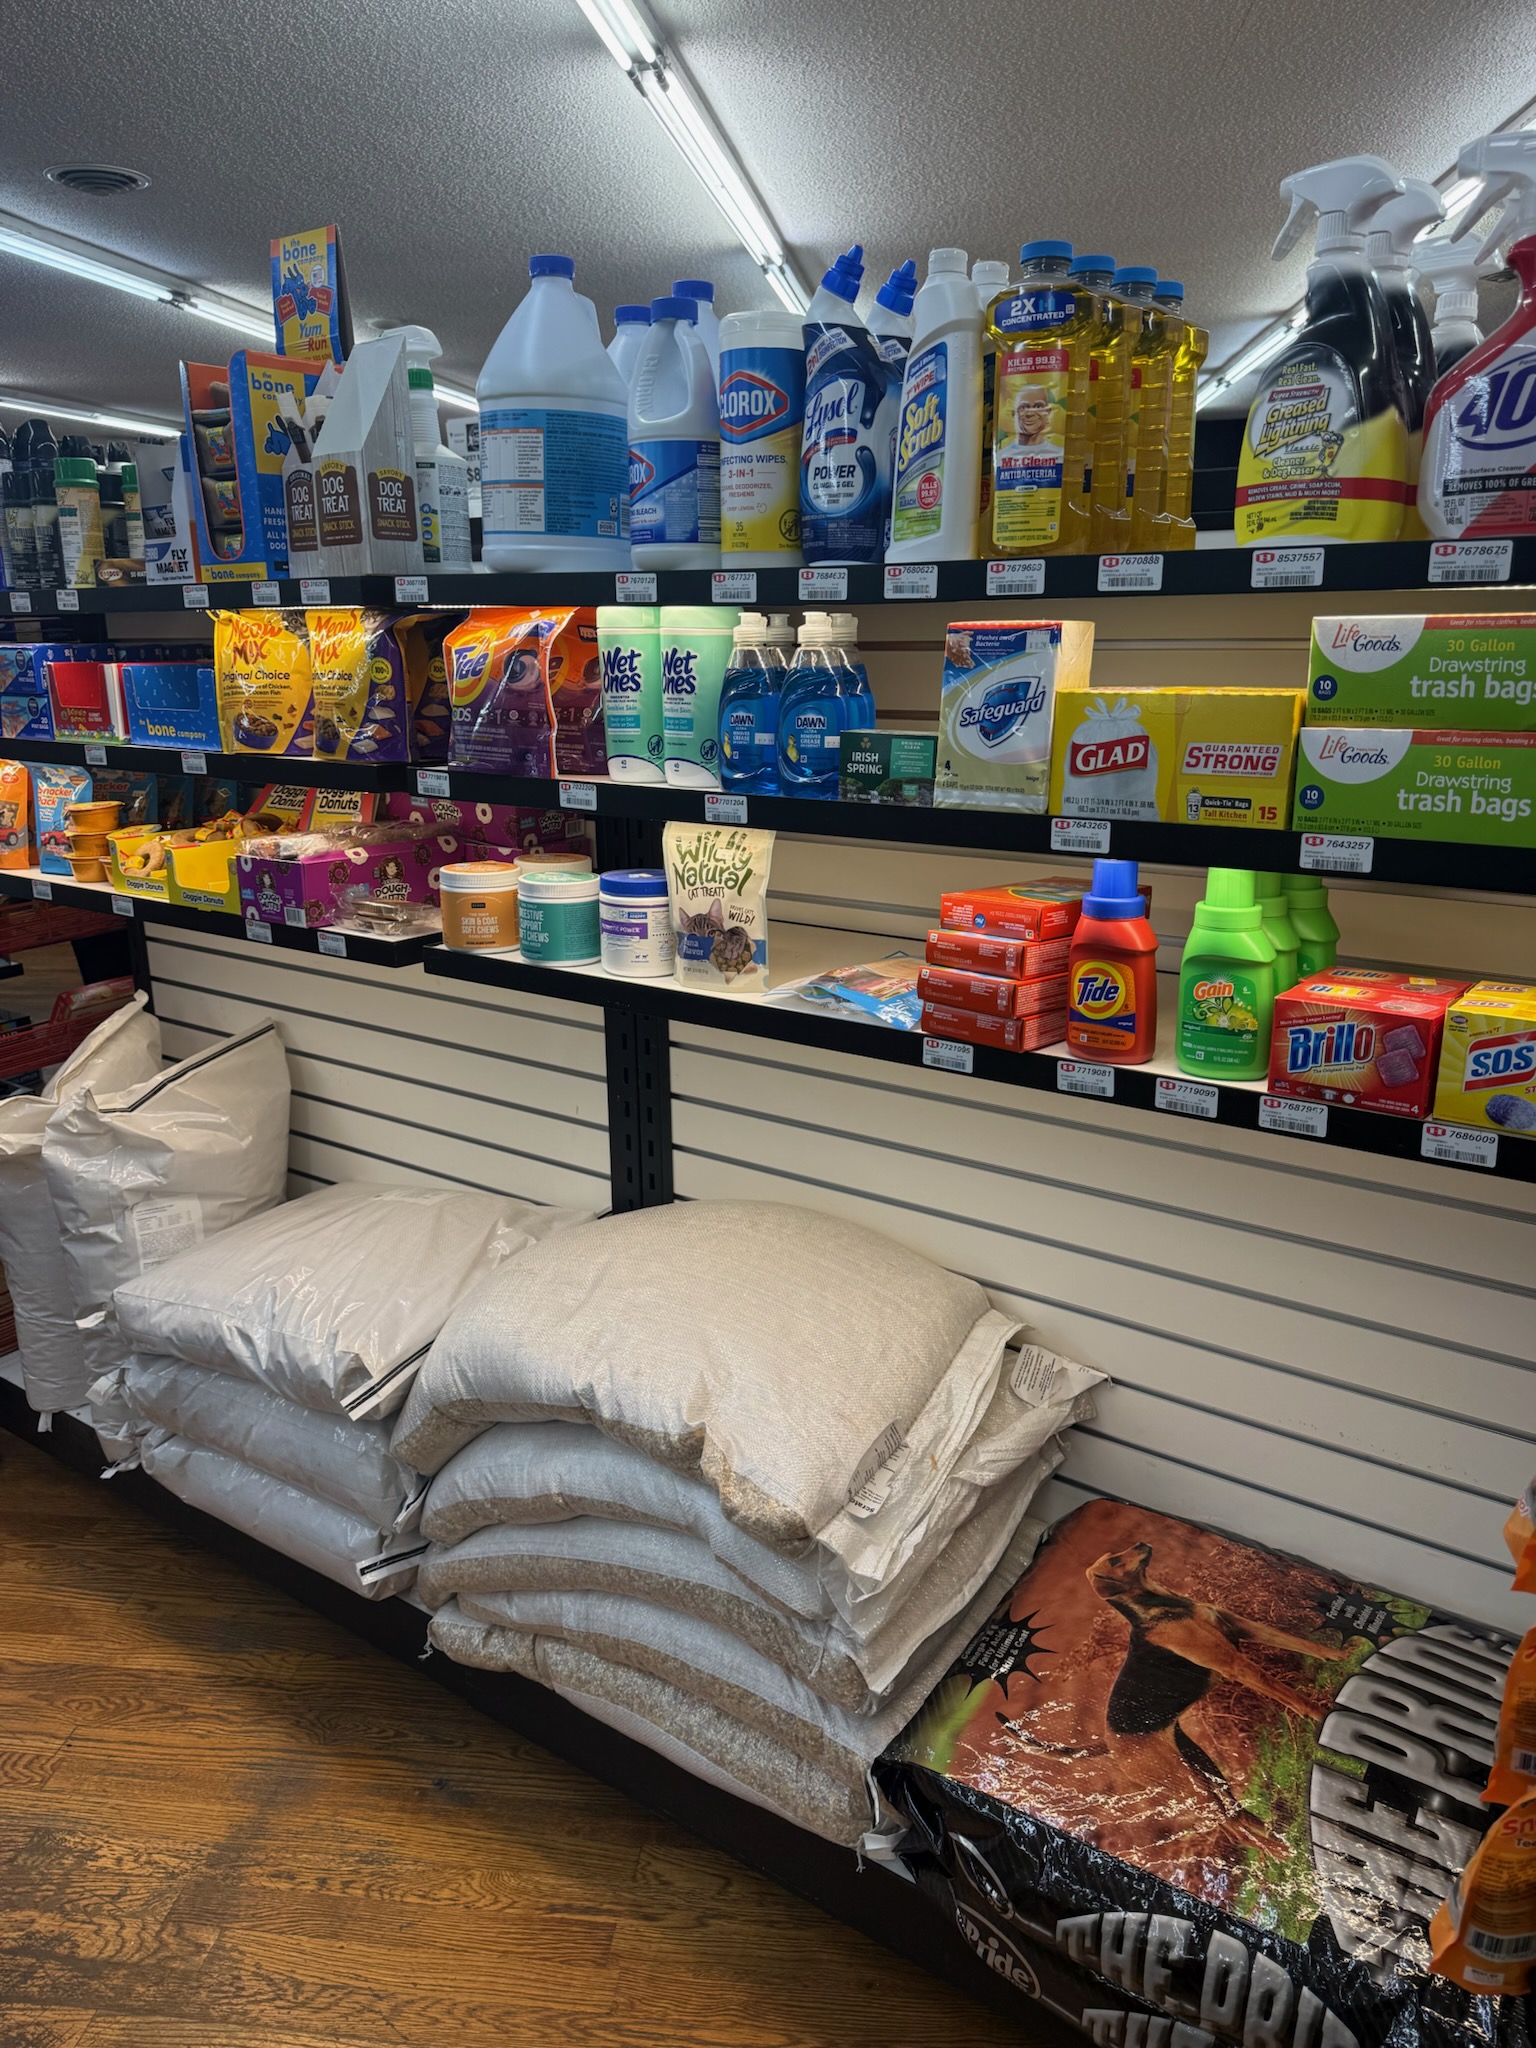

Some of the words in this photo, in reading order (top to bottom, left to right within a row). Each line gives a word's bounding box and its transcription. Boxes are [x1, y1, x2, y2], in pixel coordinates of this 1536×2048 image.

[283, 243, 316, 262] bone
[1010, 298, 1036, 317] 2X
[1001, 311, 1065, 327] CONCENTRATED
[299, 323, 322, 338] Yum
[308, 338, 327, 352] Run
[1007, 357, 1033, 367] KILLS
[1282, 365, 1299, 375] Real
[1300, 362, 1318, 372] Fast.
[251, 373, 294, 393] bone
[913, 371, 935, 391] WIPE
[1278, 377, 1295, 386] Real
[1296, 374, 1321, 384] Clean.
[720, 390, 776, 419] CLOROX
[806, 382, 859, 439] Lysol
[1266, 388, 1331, 423] Greased
[905, 392, 940, 433] Soft
[1260, 413, 1332, 444] Lightning
[899, 418, 944, 472] Scrub
[1022, 456, 1057, 467] Clean
[1272, 457, 1305, 468] Cleaner
[379, 470, 403, 479] SAVORY
[728, 469, 754, 478] 3-IN-1
[814, 465, 856, 480] POWER
[1000, 469, 1057, 480] ANTIBACTERIAL
[1271, 466, 1316, 480] Degreaser
[322, 476, 344, 495] DOG
[379, 481, 403, 497] DOG
[842, 480, 855, 488] GEL
[921, 482, 937, 491] KILLS
[1485, 478, 1506, 488] 100%
[1509, 478, 1519, 487] OF
[291, 487, 310, 503] DOG
[321, 495, 349, 514] TREAT
[377, 497, 406, 514] TREAT
[636, 507, 657, 516] BLEACH
[291, 506, 314, 521] TREAT
[323, 522, 338, 531] SNACK
[338, 520, 355, 530] STICK
[377, 519, 393, 528] SNACK
[394, 519, 411, 529] STICK
[735, 522, 743, 531] 35
[171, 549, 187, 560] FLY
[1277, 552, 1322, 562] 8537557
[1458, 546, 1508, 556] 7678675
[1120, 555, 1160, 566] 7670888
[211, 567, 235, 580] bone
[816, 571, 846, 580] 7684632
[902, 565, 935, 574] 7680622
[630, 576, 656, 584] 7670128
[727, 573, 755, 581] 7677321
[229, 617, 282, 646] Meow
[315, 610, 357, 640] Meow
[976, 634, 998, 642] Washes
[1332, 623, 1360, 649] Life
[1353, 634, 1401, 652] Goods
[1447, 639, 1465, 652] 30
[1470, 638, 1516, 652] Gallon
[454, 646, 490, 680] Tide
[602, 647, 641, 674] Wet
[662, 648, 697, 675] Wet
[1429, 656, 1527, 676] Drawstring
[255, 670, 290, 680] Choice
[603, 673, 641, 693] Ones
[1320, 680, 1331, 690] 10
[1410, 673, 1475, 698] trash
[960, 691, 1046, 728] Safeguard
[730, 714, 754, 726] DAWN
[797, 717, 826, 728] DAWN
[147, 720, 176, 737] bone
[177, 730, 206, 742] company
[1319, 735, 1348, 760] Life
[1462, 737, 1481, 745] storing
[1482, 737, 1504, 745] clothes,
[1506, 738, 1528, 746] bedding
[852, 751, 879, 762] IRISH
[1075, 741, 1145, 772] GLAD
[1204, 744, 1280, 755] GUARANTEED
[1341, 747, 1389, 765] Goods
[1185, 746, 1277, 772] STRONG
[1434, 755, 1452, 768] 30
[1457, 755, 1501, 769] Gallon
[847, 763, 883, 775] SPRING
[1416, 771, 1512, 794] Drawstring
[1305, 790, 1318, 799] 10
[319, 796, 359, 810] Donuts
[434, 803, 459, 814] DOUGH
[718, 798, 745, 806] 7701204
[1188, 804, 1199, 812] 13
[1234, 800, 1249, 809] Bags
[1397, 789, 1468, 813] trash
[1470, 790, 1532, 822] bags
[1204, 809, 1217, 818] Tall
[1219, 810, 1247, 819] Kitchen
[1259, 806, 1277, 820] 15
[1071, 821, 1108, 830] 7643265
[676, 830, 753, 871] Wildly
[1326, 839, 1371, 850] 7643257
[673, 860, 753, 896] Natural
[126, 879, 143, 891] Doggie
[144, 882, 164, 892] Donuts
[375, 885, 408, 898] DOUGH
[183, 892, 203, 904] Doggie
[204, 895, 224, 906] Donuts
[688, 888, 699, 900] CAT
[699, 886, 725, 898] TREATS
[462, 917, 475, 925] SKIN
[482, 916, 498, 925] COAT
[728, 910, 756, 926] WILD!
[461, 925, 476, 934] SOFT
[477, 925, 499, 934] CHEWS
[527, 932, 549, 943] CHEWS
[1077, 976, 1120, 1006] Tide
[1194, 981, 1234, 1000] Gain
[940, 1041, 971, 1054] 7721095
[1288, 1023, 1375, 1073] Brillo
[1077, 1066, 1112, 1078] 7719081
[1177, 1085, 1216, 1099] 7719099
[1283, 1102, 1324, 1116] 7687957
[1411, 1105, 1419, 1114] 4
[1449, 1130, 1496, 1146] 7686009
[978, 1647, 995, 1667] Fatty
[990, 1628, 1007, 1647] Acids
[995, 1628, 1018, 1658] Ultimate
[966, 1642, 986, 1667] Omega
[1000, 1656, 1015, 1674] Skin
[1015, 1629, 1030, 1647] Coat
[965, 1920, 1034, 1990] Pride
[1055, 1911, 1195, 2008] THE
